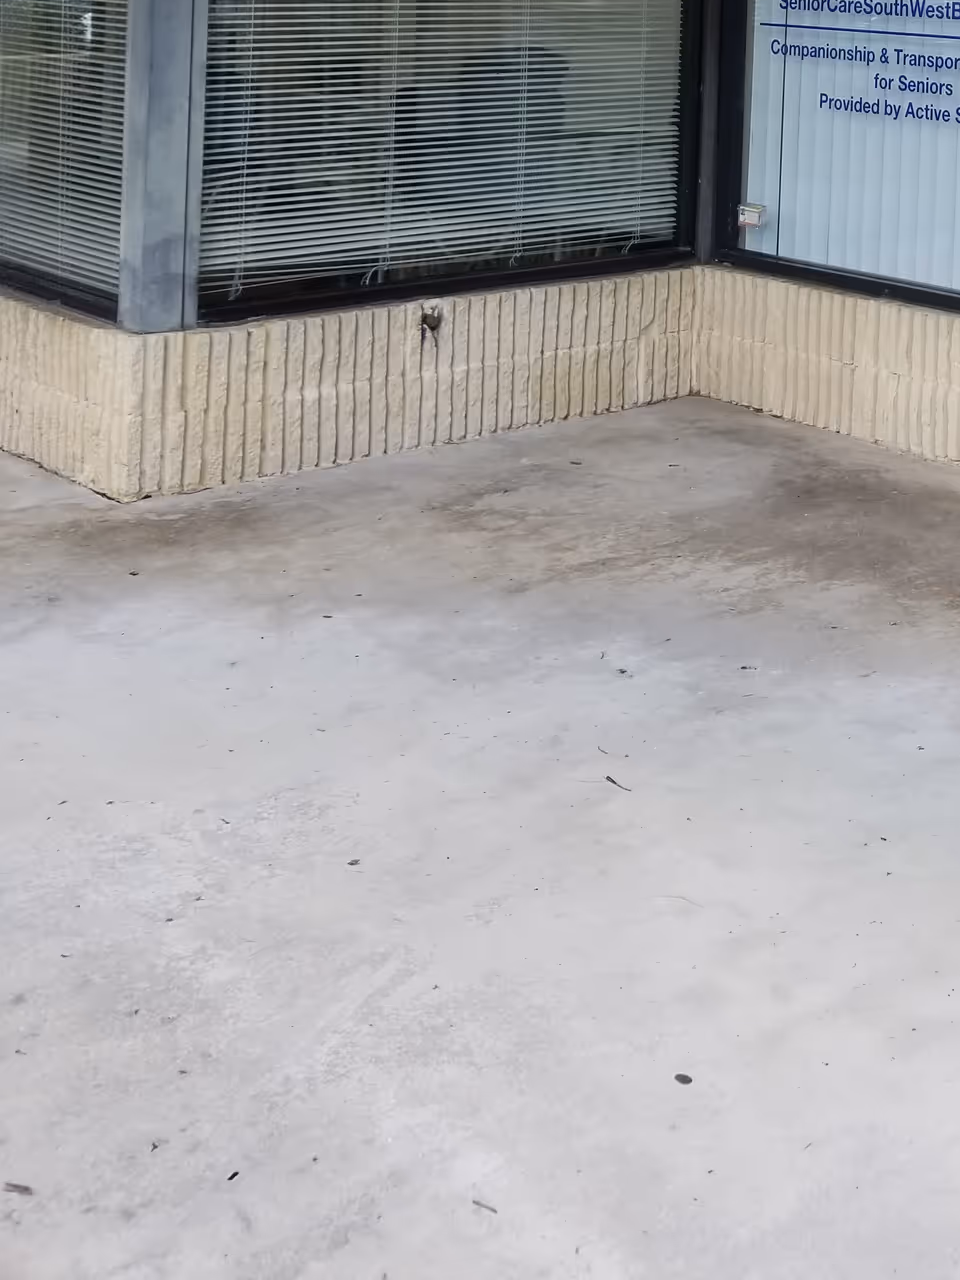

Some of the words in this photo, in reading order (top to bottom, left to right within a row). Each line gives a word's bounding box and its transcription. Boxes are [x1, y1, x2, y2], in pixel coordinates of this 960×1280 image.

[770, 38, 876, 68] Companionship
[880, 48, 890, 65] &
[873, 73, 894, 91] for
[897, 75, 954, 98] Seniors
[819, 93, 881, 117] Provided
[884, 101, 901, 120] by
[905, 101, 951, 123] Active
